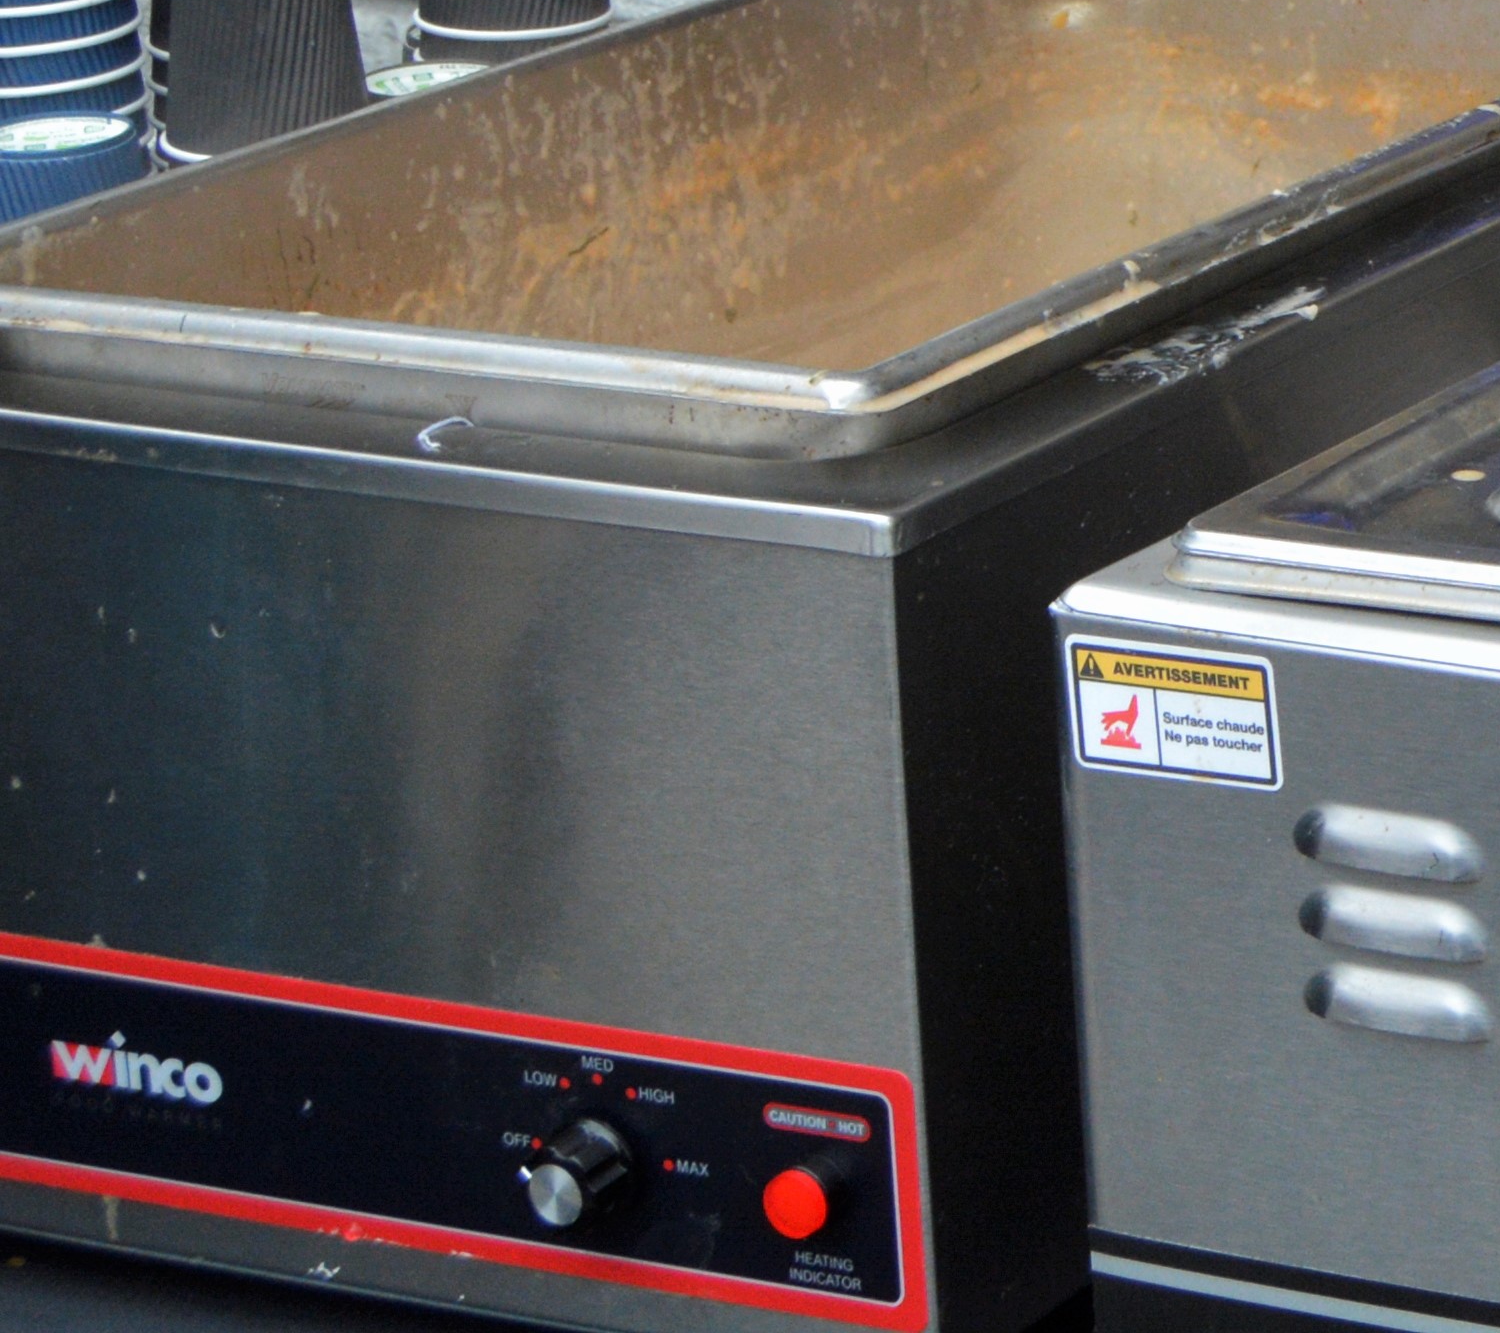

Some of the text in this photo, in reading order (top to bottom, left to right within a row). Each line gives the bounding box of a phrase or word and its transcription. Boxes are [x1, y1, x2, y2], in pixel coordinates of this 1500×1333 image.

[1113, 661, 1250, 691] AVERTISSEMENT
[1163, 712, 1265, 736] Surface chaude
[1164, 730, 1263, 753] Ne pas toucher
[50, 1030, 223, 1104] winco
[580, 1055, 615, 1073] MED
[523, 1070, 557, 1088] LOW
[638, 1086, 675, 1104] HIGH
[768, 1109, 865, 1137] CAUTION HOT
[503, 1131, 531, 1148] OFF
[675, 1159, 709, 1177] MAX
[794, 1251, 854, 1272] HEATING
[789, 1268, 862, 1291] INDICATOR
